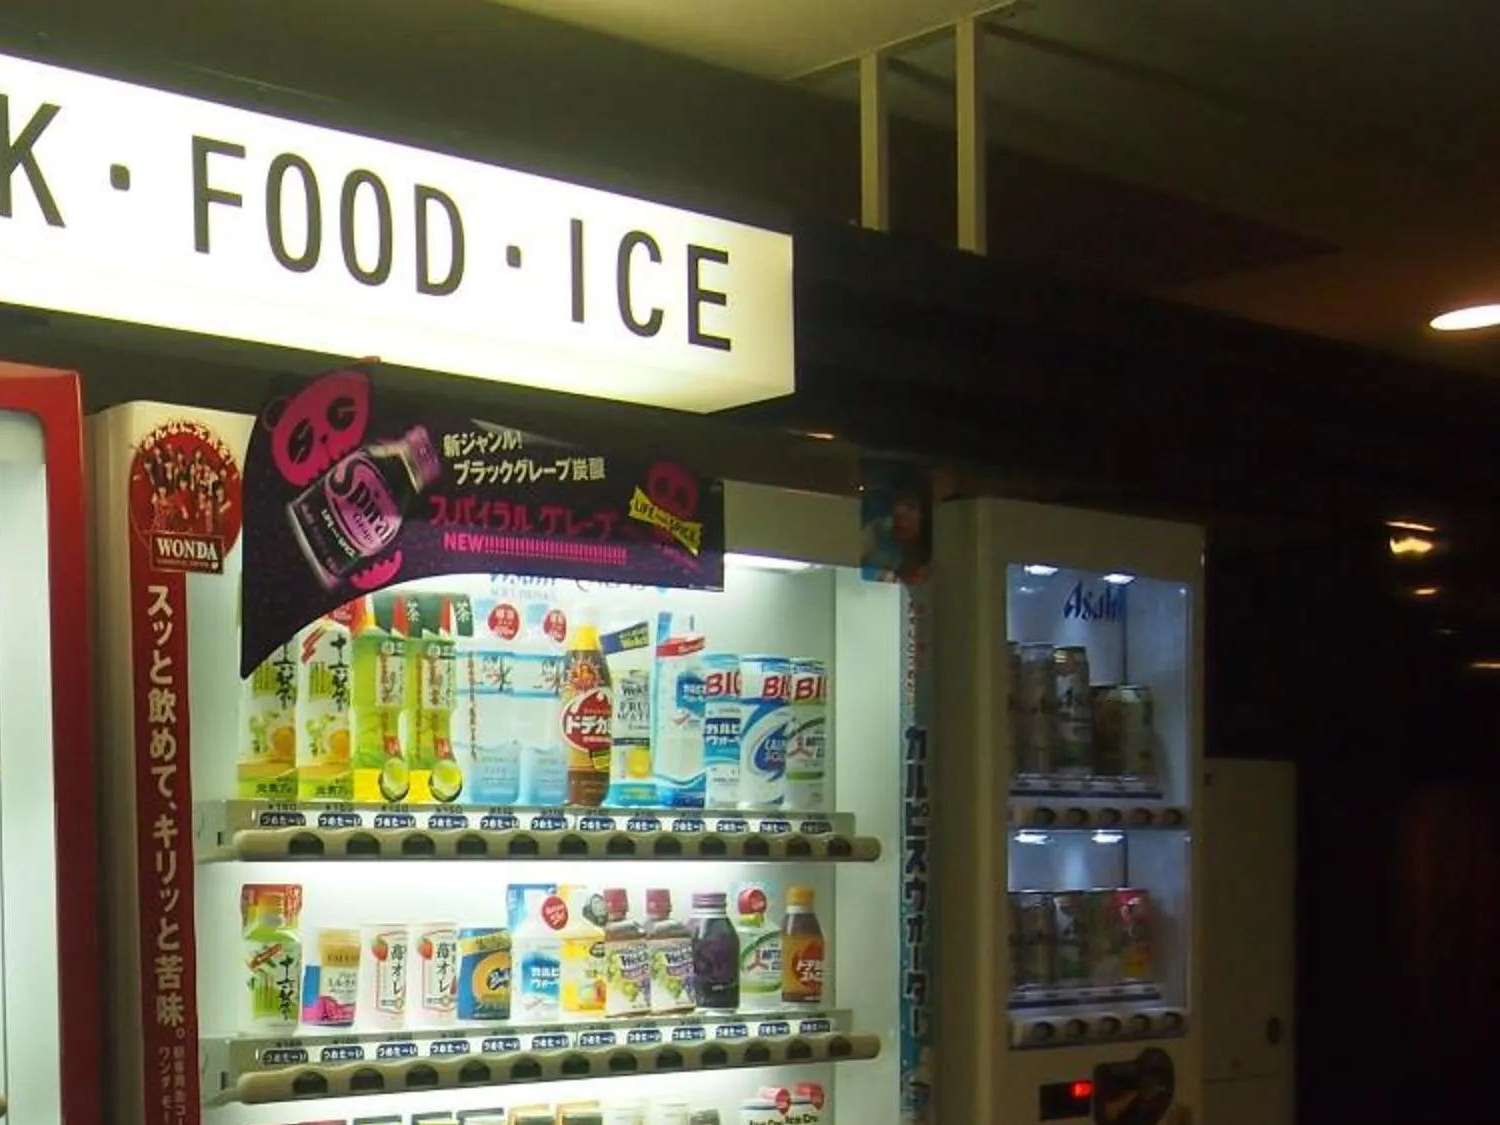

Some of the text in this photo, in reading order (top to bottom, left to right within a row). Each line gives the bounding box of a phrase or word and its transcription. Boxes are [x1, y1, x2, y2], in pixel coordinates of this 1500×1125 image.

[190, 135, 467, 298] FOOD
[570, 218, 733, 353] ICE
[442, 430, 524, 458] 新ジャンル!
[452, 457, 606, 487] ブラックグレープ炭酸
[428, 495, 534, 532] スパイラル
[156, 537, 219, 561] WONDA
[1062, 580, 1124, 624] Asahi
[328, 632, 350, 712] 十六茶
[903, 724, 929, 1038] カルピスウォーター
[276, 956, 297, 1021] 十六茶
